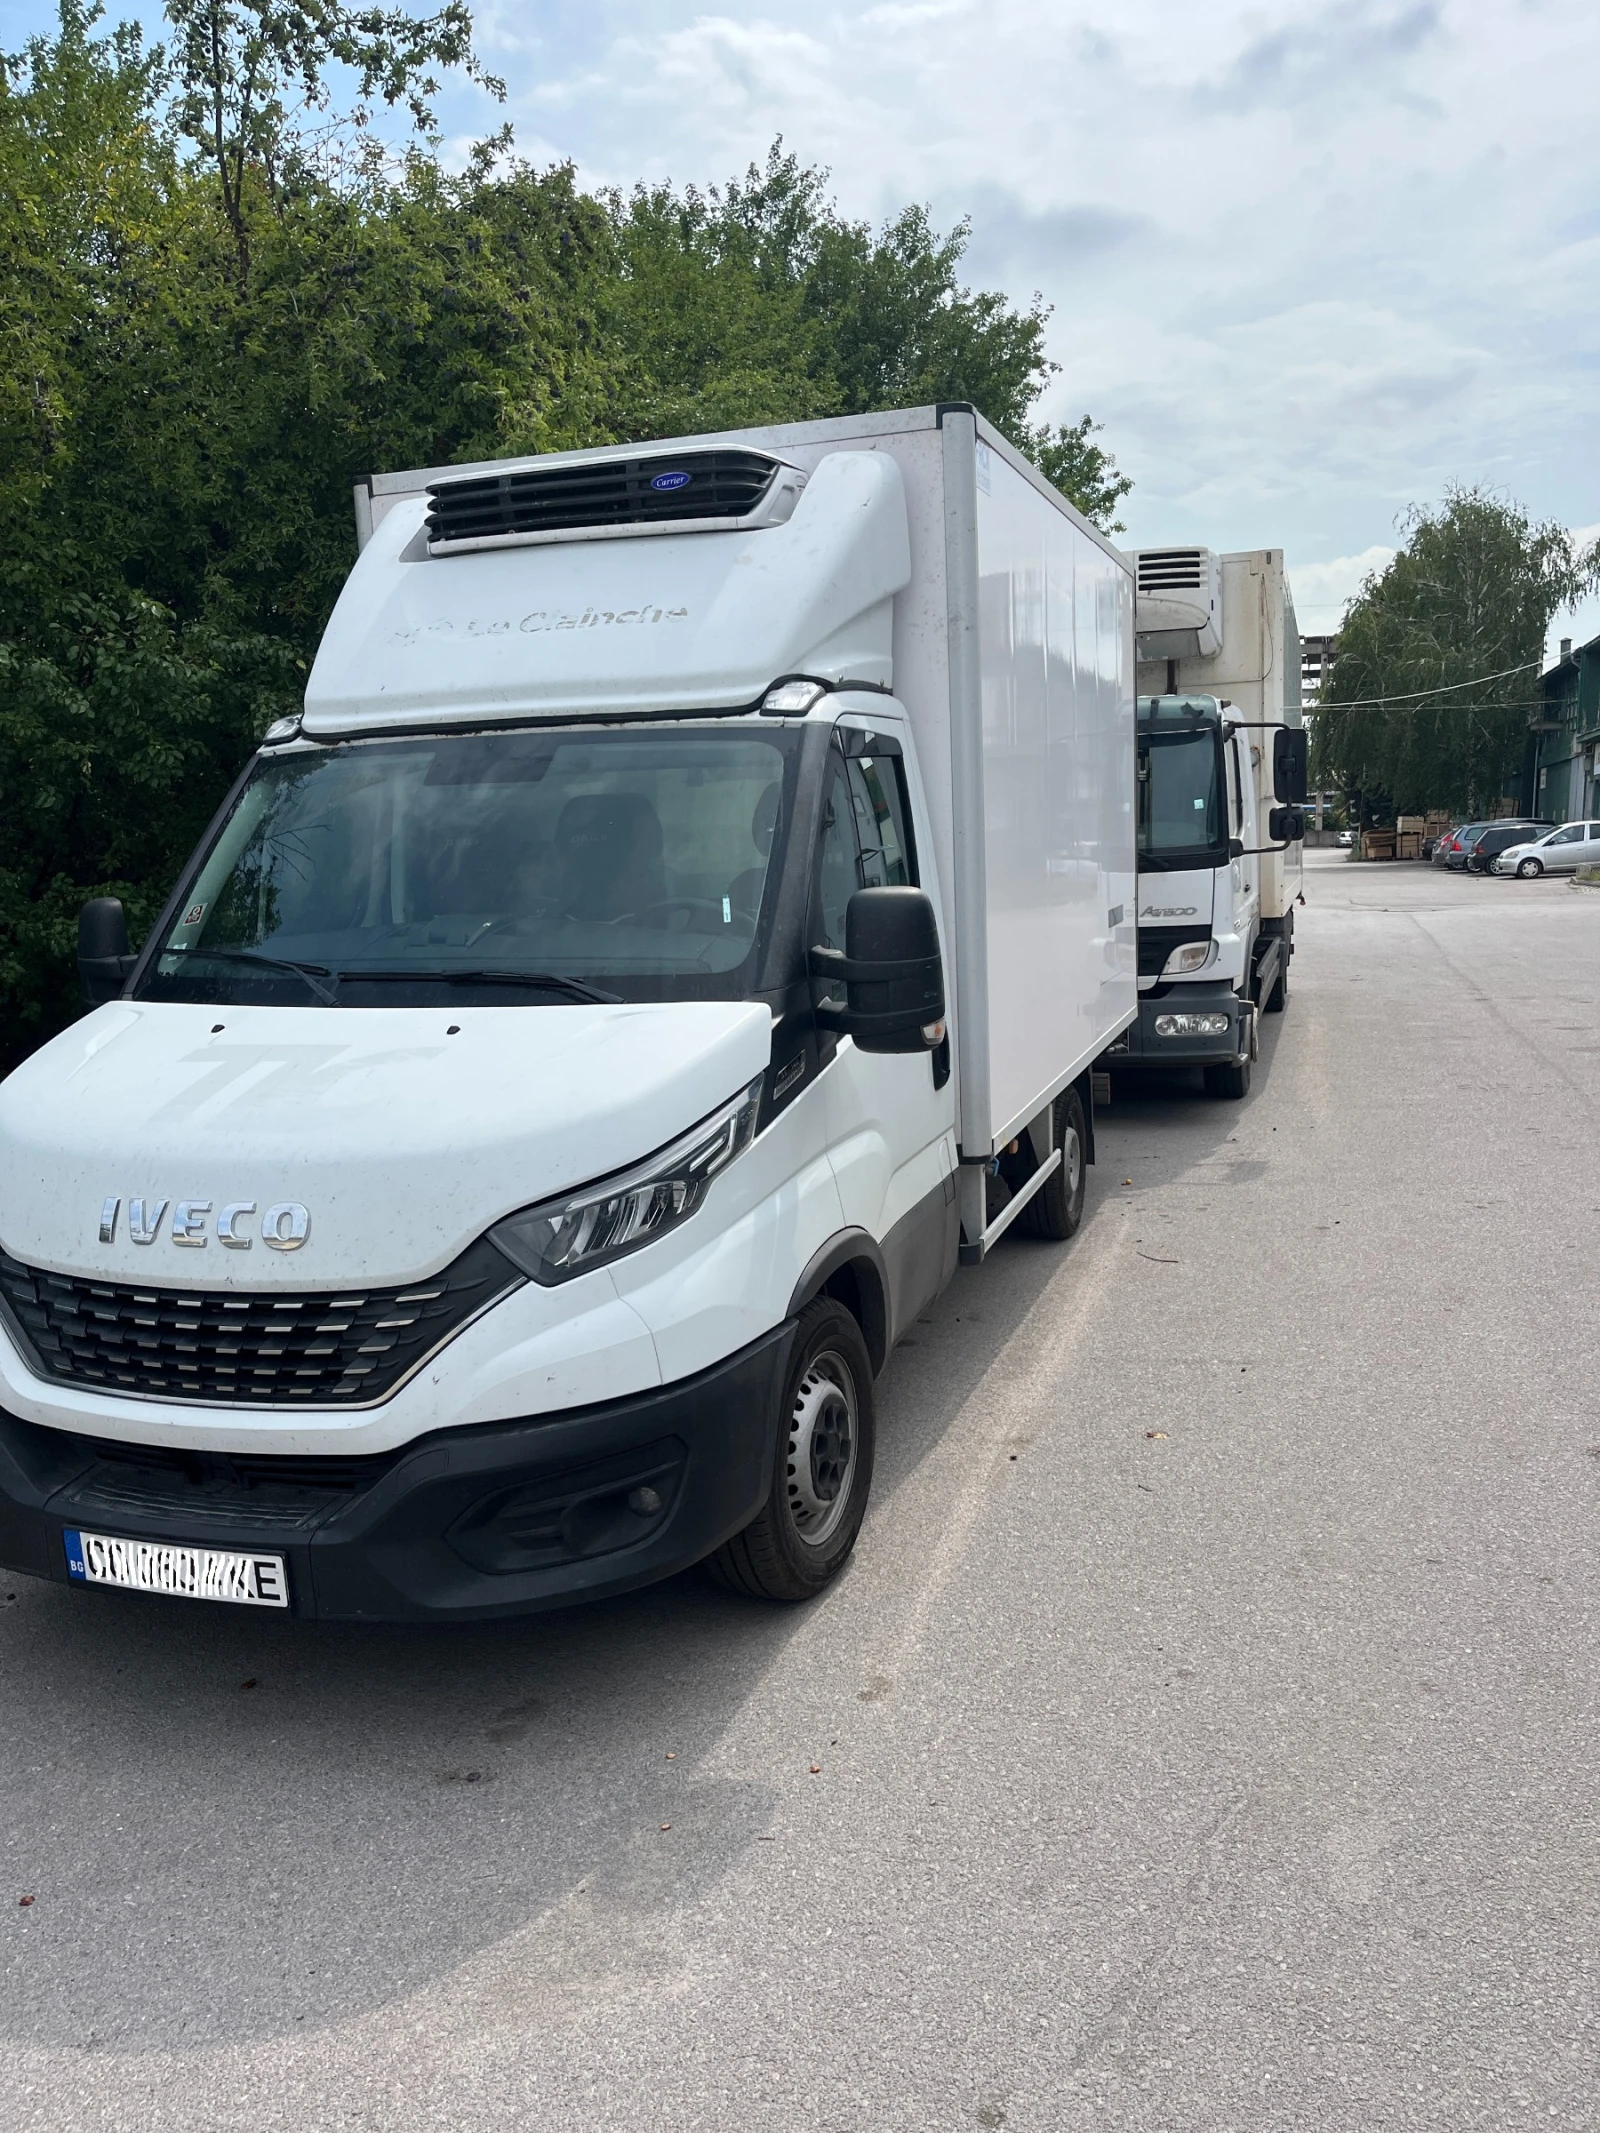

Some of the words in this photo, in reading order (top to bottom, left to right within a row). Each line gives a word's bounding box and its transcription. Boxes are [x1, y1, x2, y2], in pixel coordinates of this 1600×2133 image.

[656, 476, 685, 488] Carrier
[98, 1197, 311, 1251] IVECO
[70, 1560, 84, 1573] BG
